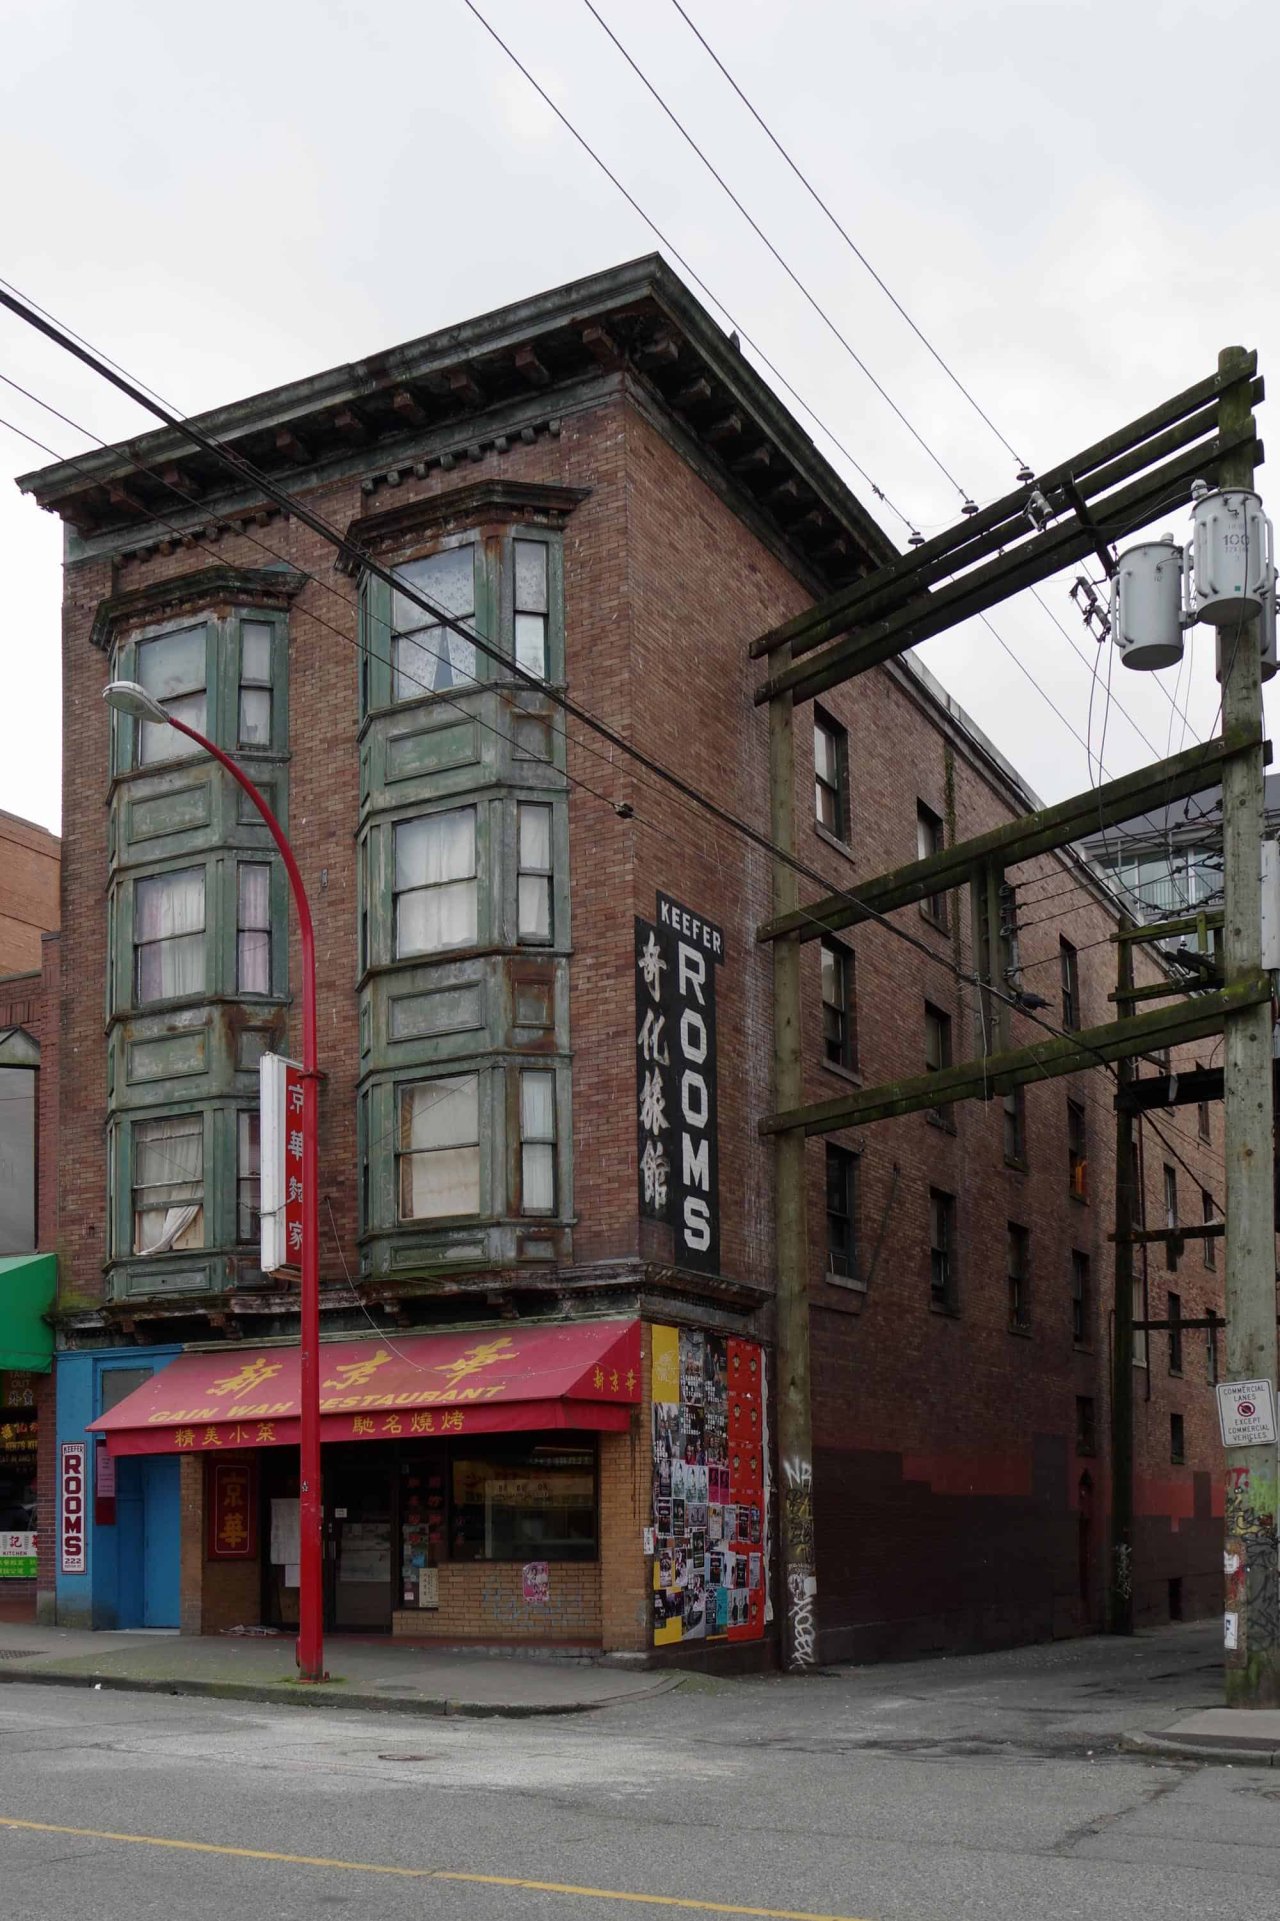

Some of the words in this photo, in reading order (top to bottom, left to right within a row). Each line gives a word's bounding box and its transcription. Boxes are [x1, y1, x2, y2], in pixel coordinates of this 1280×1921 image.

[660, 899, 722, 954] KEEFER
[678, 940, 711, 1253] ROOMS
[1223, 1384, 1265, 1396] COMMERCIAL
[1234, 1394, 1257, 1402] LANES
[148, 1406, 219, 1423] GAIN
[227, 1401, 295, 1418] WAH
[1235, 1416, 1261, 1426] EXCEPT
[174, 1422, 277, 1448] 精美小菜
[1228, 1425, 1270, 1434] COMMERCIAL
[1233, 1432, 1267, 1441] VEHICLES
[64, 1445, 84, 1454] KEEFER
[64, 1454, 82, 1557] ROOMS
[64, 1557, 82, 1565] 222
